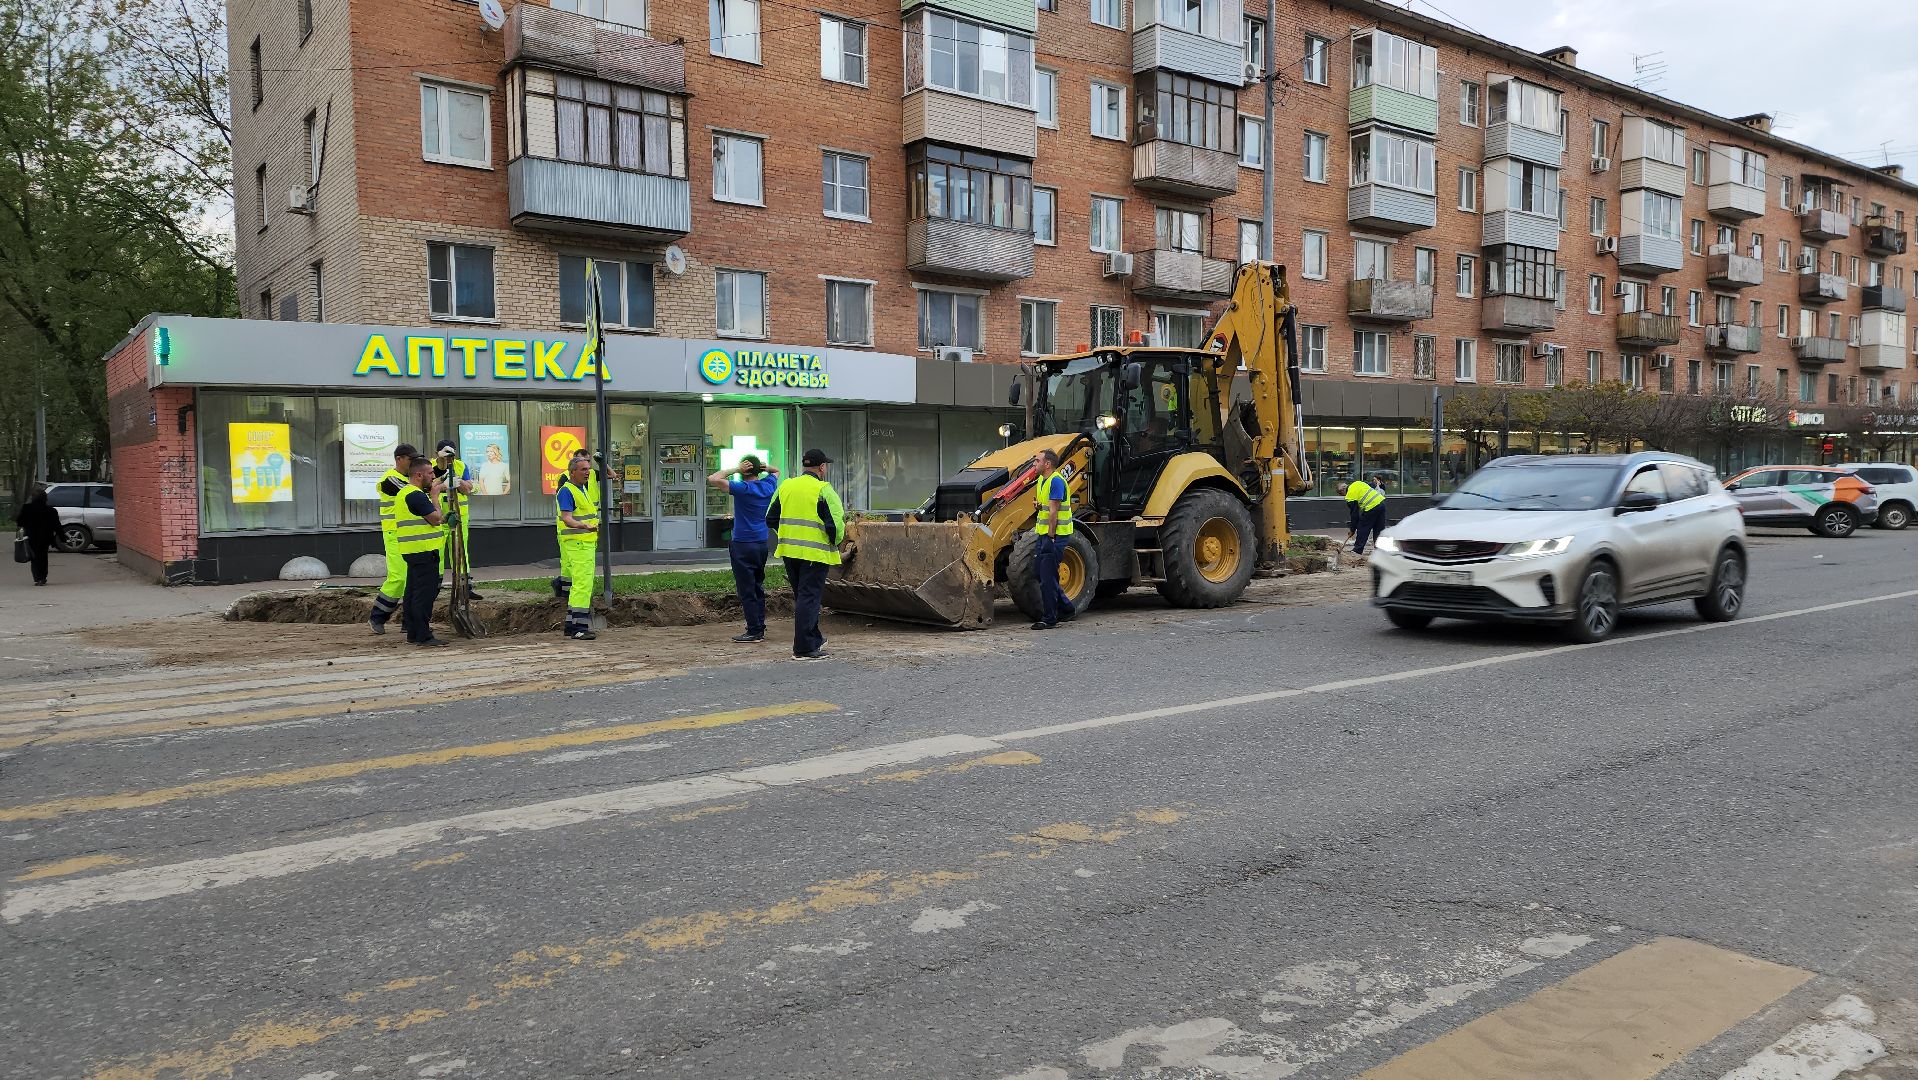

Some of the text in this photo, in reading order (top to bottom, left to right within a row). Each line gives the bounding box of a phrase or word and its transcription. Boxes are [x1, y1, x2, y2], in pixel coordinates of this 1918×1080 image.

[353, 334, 613, 382] АПТЕКА
[736, 350, 822, 371] ПЛАНЕТА
[736, 368, 830, 388] ЗДОРОВЬЯ
